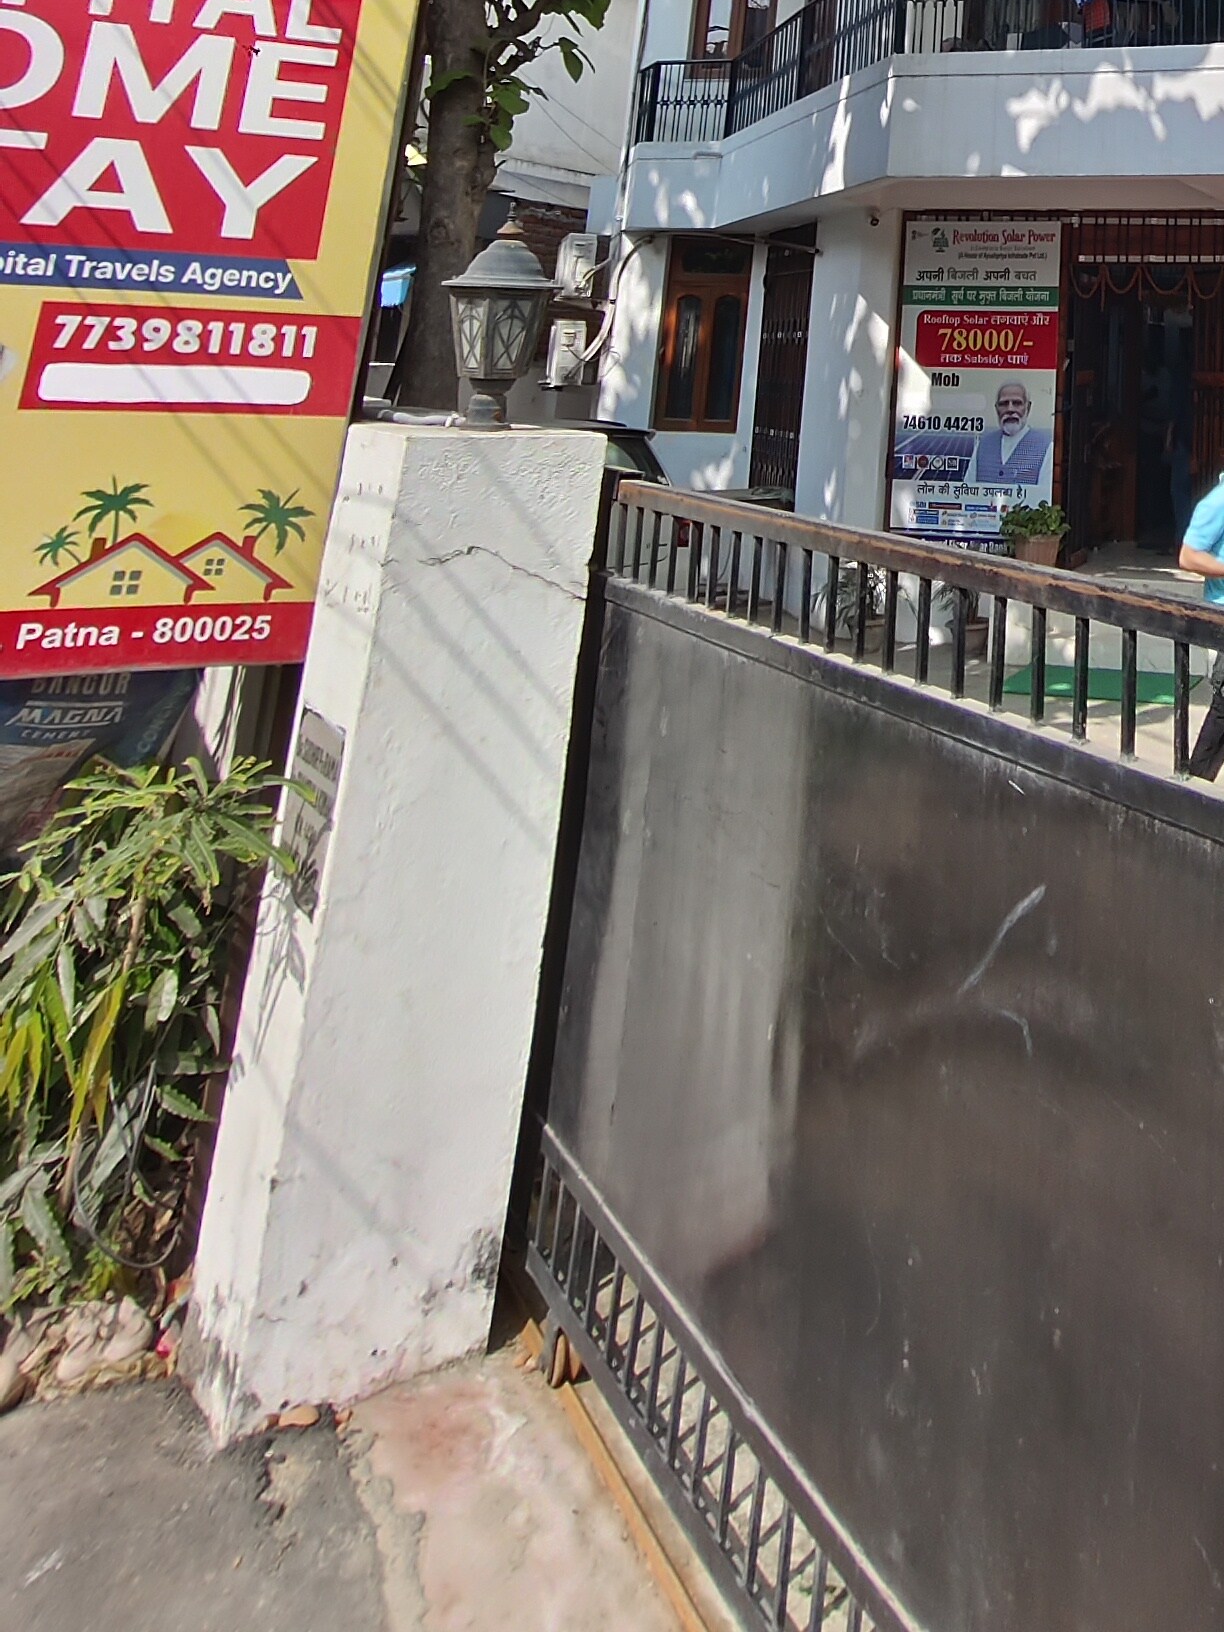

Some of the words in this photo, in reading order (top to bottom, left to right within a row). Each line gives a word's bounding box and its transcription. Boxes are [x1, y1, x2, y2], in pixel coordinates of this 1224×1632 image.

[953, 229, 999, 245] Revolution
[1002, 229, 1026, 245] Solar
[1028, 229, 1056, 245] Power
[0, 250, 57, 277] ital
[65, 254, 175, 283] Travels
[182, 262, 293, 294] Agency
[916, 267, 944, 281] अपनी
[948, 267, 979, 281] बिजली
[983, 267, 1010, 281] अपनी
[1014, 270, 1037, 281] बचत
[1000, 287, 1022, 301] बिजली
[1025, 288, 1049, 301] योजना
[924, 314, 961, 327] Rooftop
[963, 315, 989, 325] Solar
[1031, 312, 1050, 325] और
[53, 315, 318, 358] 7739811811
[937, 328, 1034, 352] 78000/-
[940, 353, 962, 363] तक
[964, 354, 1005, 366] Subsidy
[931, 372, 960, 387] Mob
[903, 415, 941, 430] 74610
[944, 416, 984, 432] 44213
[917, 481, 935, 495] लोन
[939, 483, 950, 495] की
[953, 483, 979, 499] सुविधा
[16, 622, 120, 650] Patna
[153, 615, 272, 644] 800025
[5, 706, 126, 727] MAGNA
[21, 729, 92, 740] CEMENT
